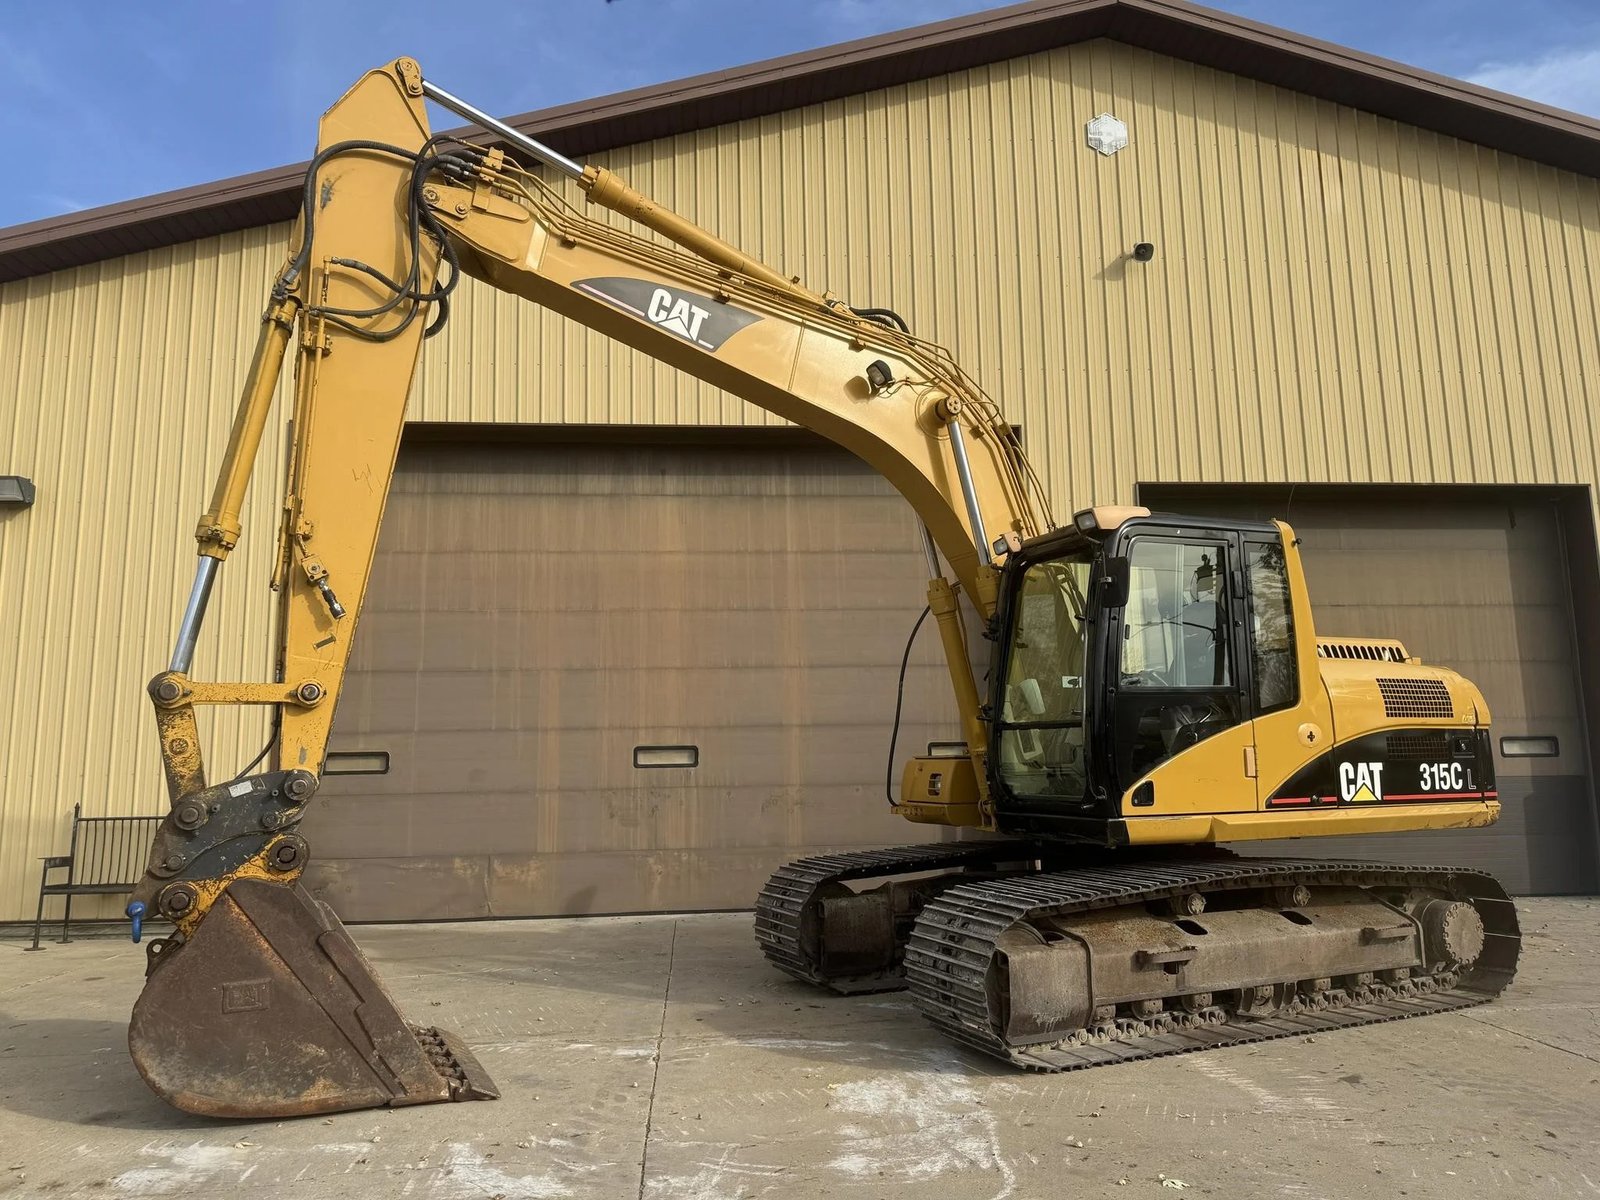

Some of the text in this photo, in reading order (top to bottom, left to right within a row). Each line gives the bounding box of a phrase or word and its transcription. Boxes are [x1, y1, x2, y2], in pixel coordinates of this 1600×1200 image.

[648, 288, 710, 342] CAT
[1339, 761, 1383, 802] CAT
[1419, 763, 1477, 791] 315C L
